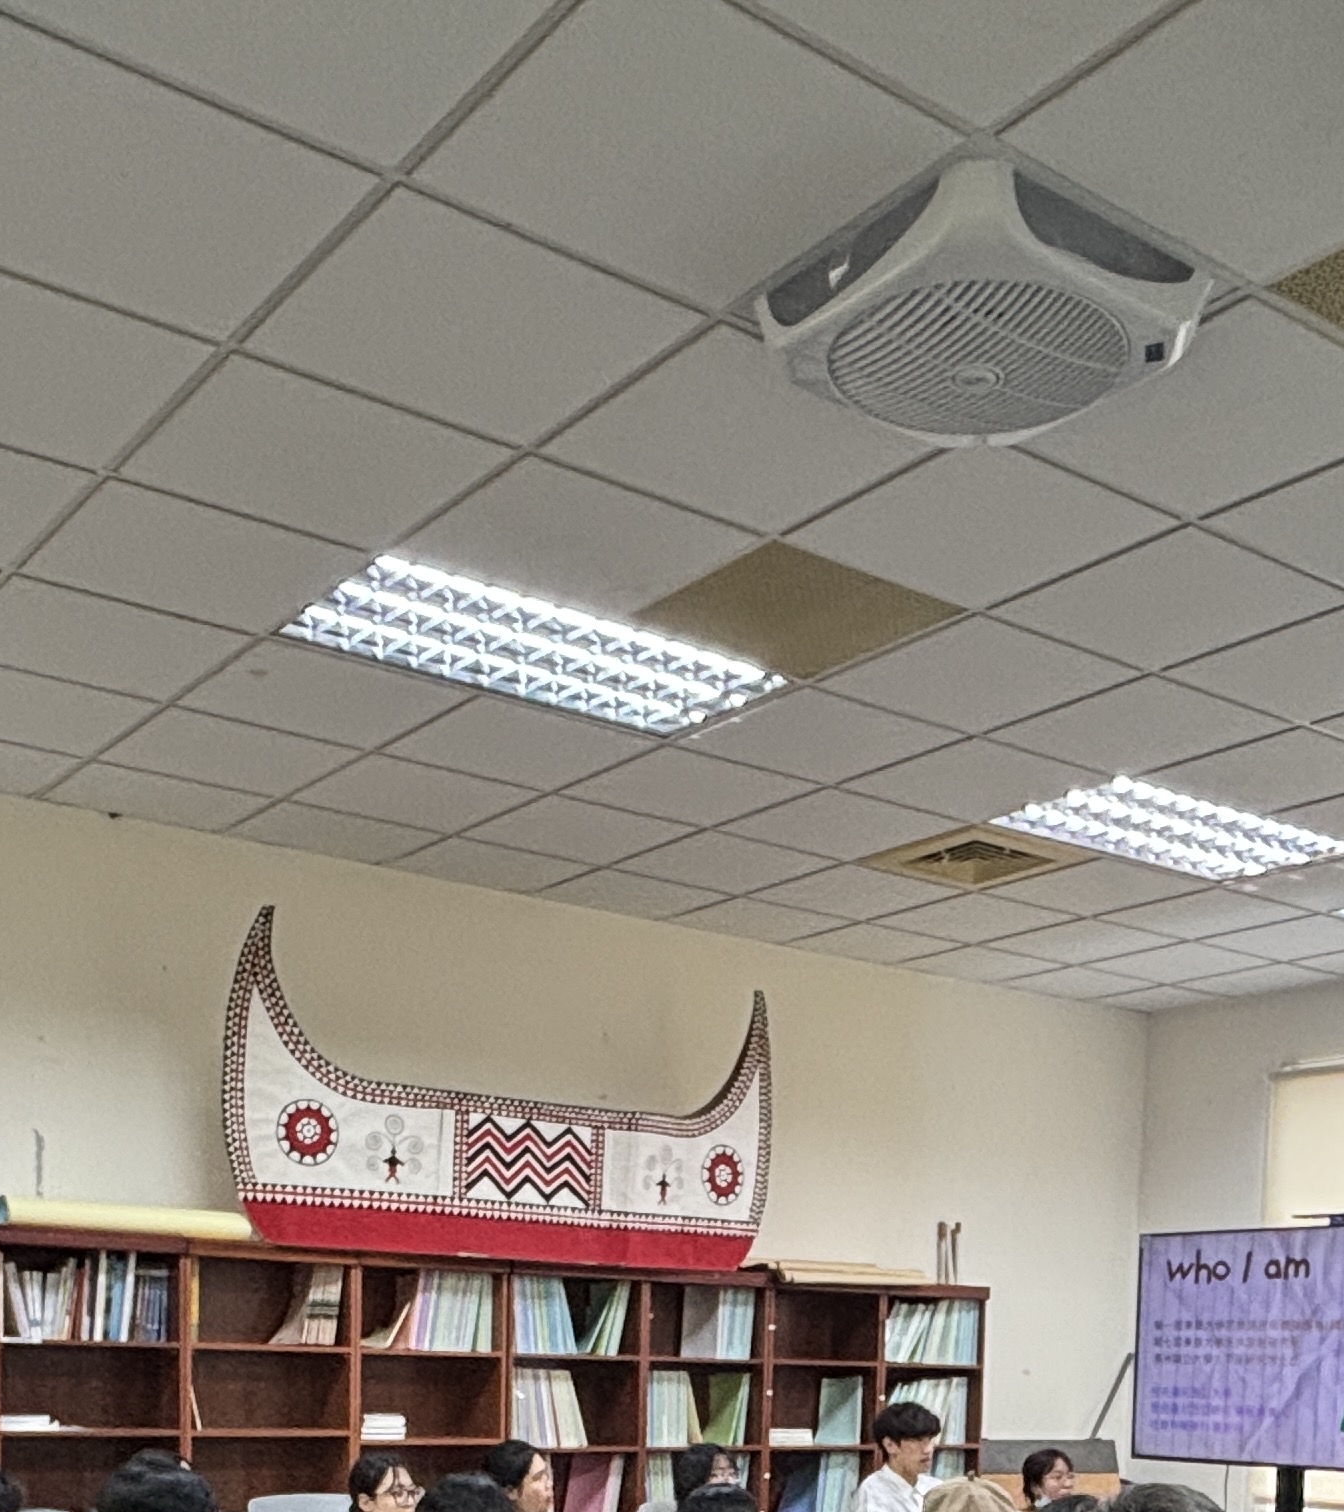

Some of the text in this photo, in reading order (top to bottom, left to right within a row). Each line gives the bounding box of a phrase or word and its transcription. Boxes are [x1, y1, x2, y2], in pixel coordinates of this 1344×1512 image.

[1166, 1249, 1311, 1285] who I am
